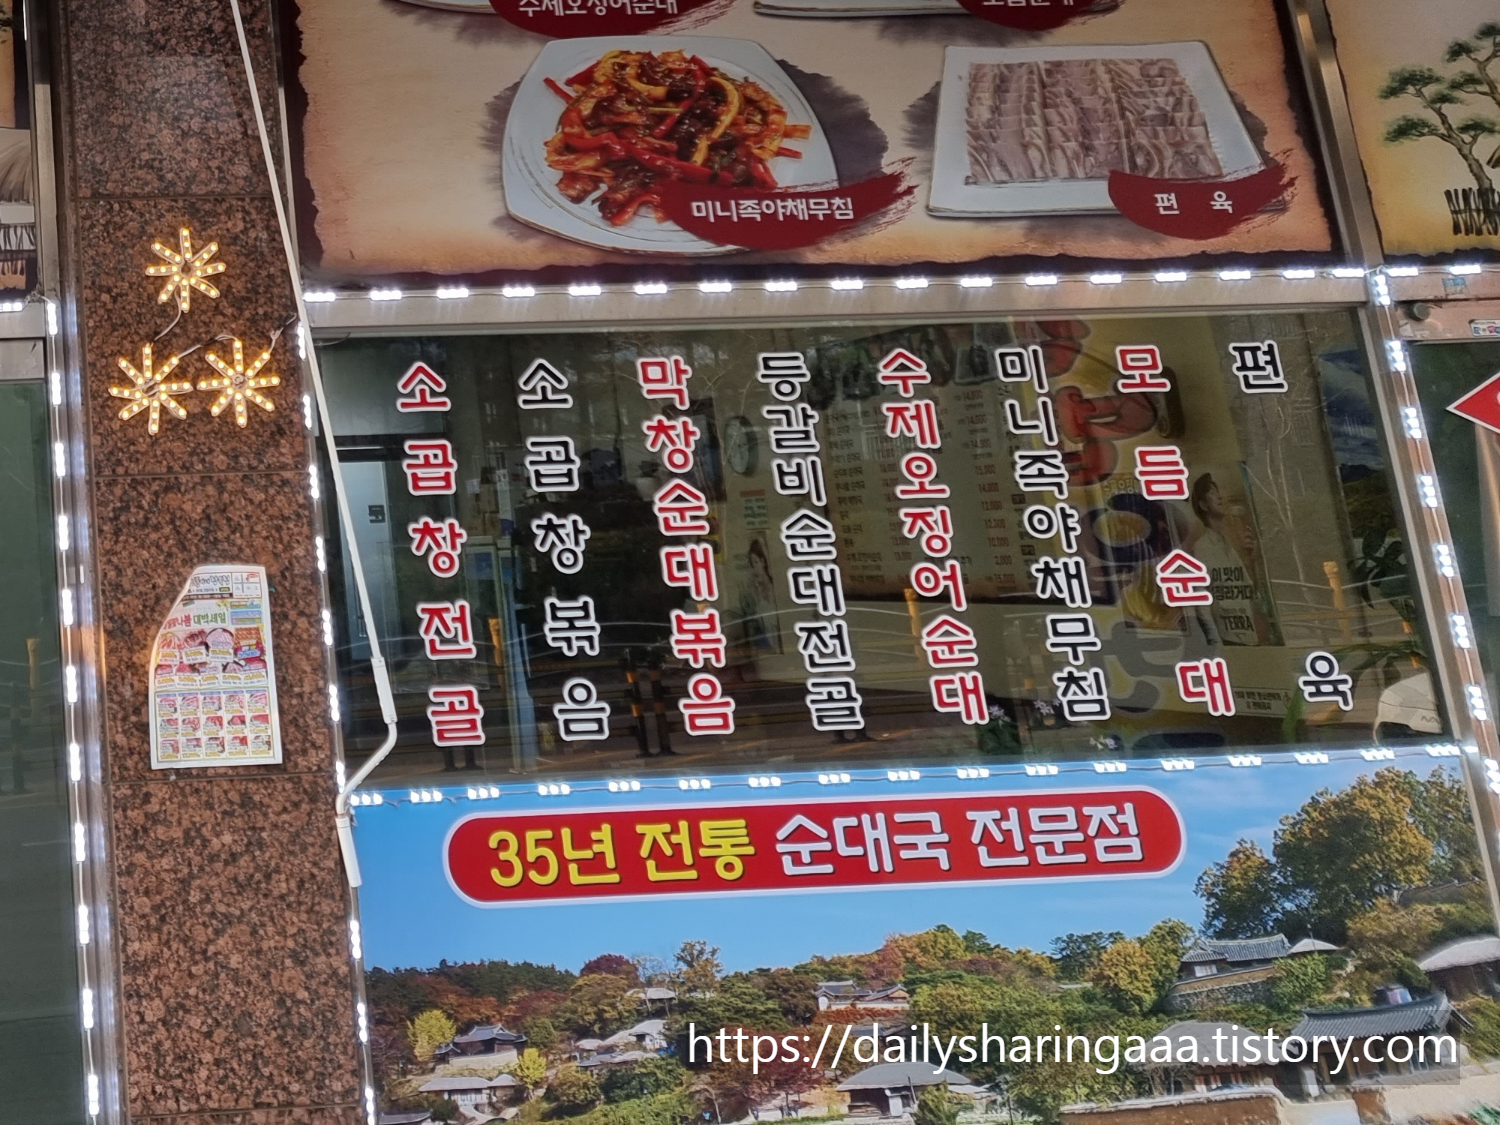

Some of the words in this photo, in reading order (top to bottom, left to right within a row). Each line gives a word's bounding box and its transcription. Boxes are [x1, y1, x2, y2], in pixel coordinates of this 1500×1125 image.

[691, 197, 855, 223] 미니족야채무침
[396, 360, 486, 748] 소곱창전골
[517, 356, 610, 743] 소곱창볶음
[637, 354, 736, 737] 막창순대볶음
[756, 351, 866, 732] 등갈비순대전골
[877, 347, 989, 725] 수제오징어순대
[995, 344, 1111, 721] 미니족야채무침
[1115, 344, 1236, 718] 모듬순대
[1220, 615, 1255, 632] TERRA
[487, 822, 621, 891] 35년
[636, 817, 756, 883] 전통
[773, 809, 951, 878] 순대국
[964, 801, 1144, 870] 전문점
